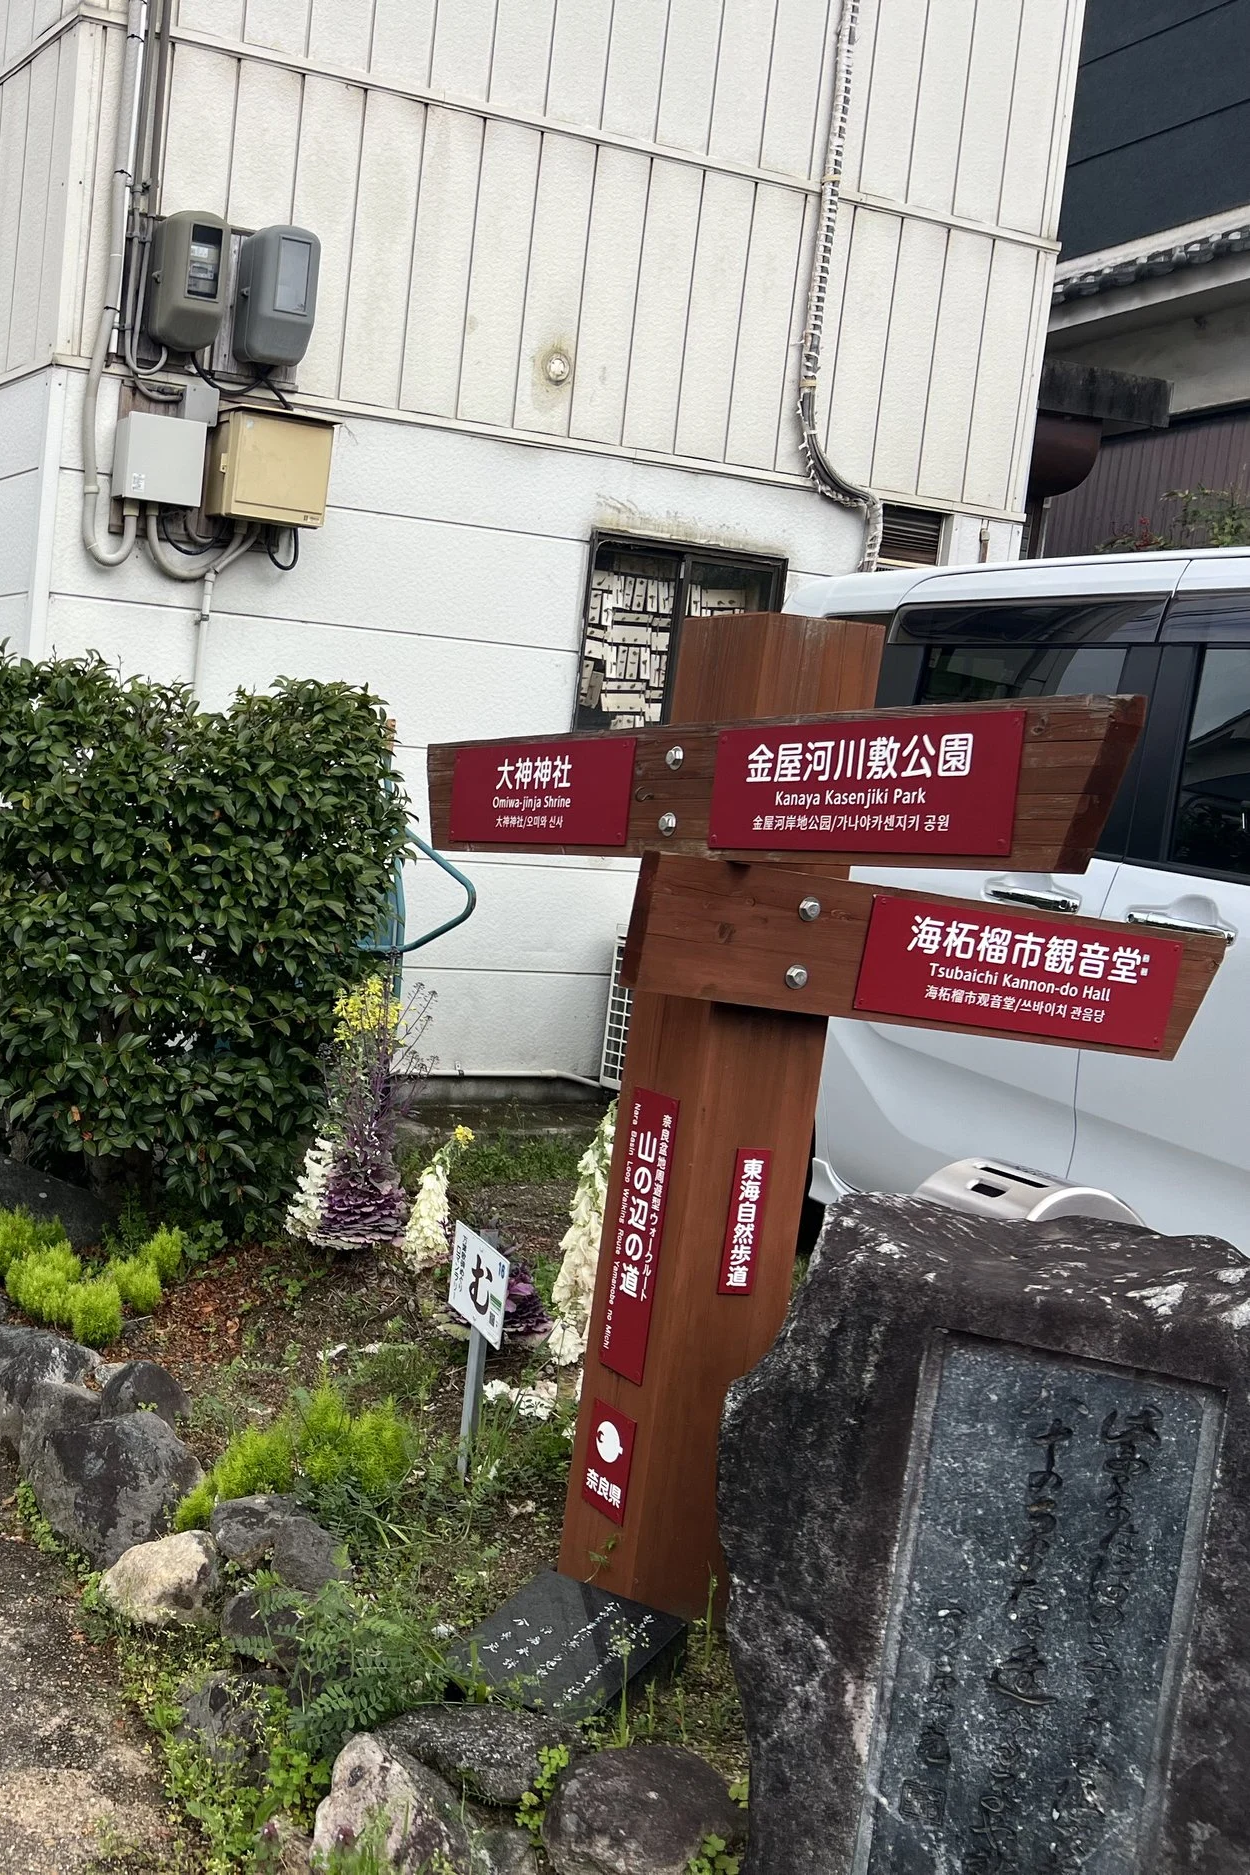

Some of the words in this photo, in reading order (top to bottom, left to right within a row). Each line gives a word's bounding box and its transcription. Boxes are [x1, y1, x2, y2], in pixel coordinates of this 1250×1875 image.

[745, 732, 974, 783] 金屋河川敷公園
[495, 754, 573, 790] 大神神社
[492, 796, 541, 812] Omiwa-jinja
[543, 795, 571, 809] Shrine
[775, 790, 821, 810] Kanaya
[824, 788, 889, 809] Kasenjiki
[893, 787, 927, 805] Park
[548, 815, 564, 829] 신사
[923, 814, 950, 832] 공원
[906, 915, 1142, 985] 海柘榴市観音堂
[928, 962, 999, 986] Tsubaichi
[1001, 973, 1079, 998] Kannon-do
[1082, 984, 1112, 1002] Hall
[1069, 1006, 1106, 1024] 관음당
[632, 1102, 642, 1126] Nara
[628, 1130, 638, 1156] Basin
[624, 1160, 634, 1183] Loop
[618, 1188, 630, 1224] Walking
[618, 1130, 658, 1299] 山の辺の道
[725, 1158, 765, 1287] 東海自然歩道
[615, 1228, 625, 1255] Route
[468, 1253, 493, 1316] む
[608, 1261, 621, 1305] Yamanobe
[606, 1309, 613, 1321] no
[603, 1324, 612, 1350] Michi
[585, 1467, 622, 1509] 奈良県
